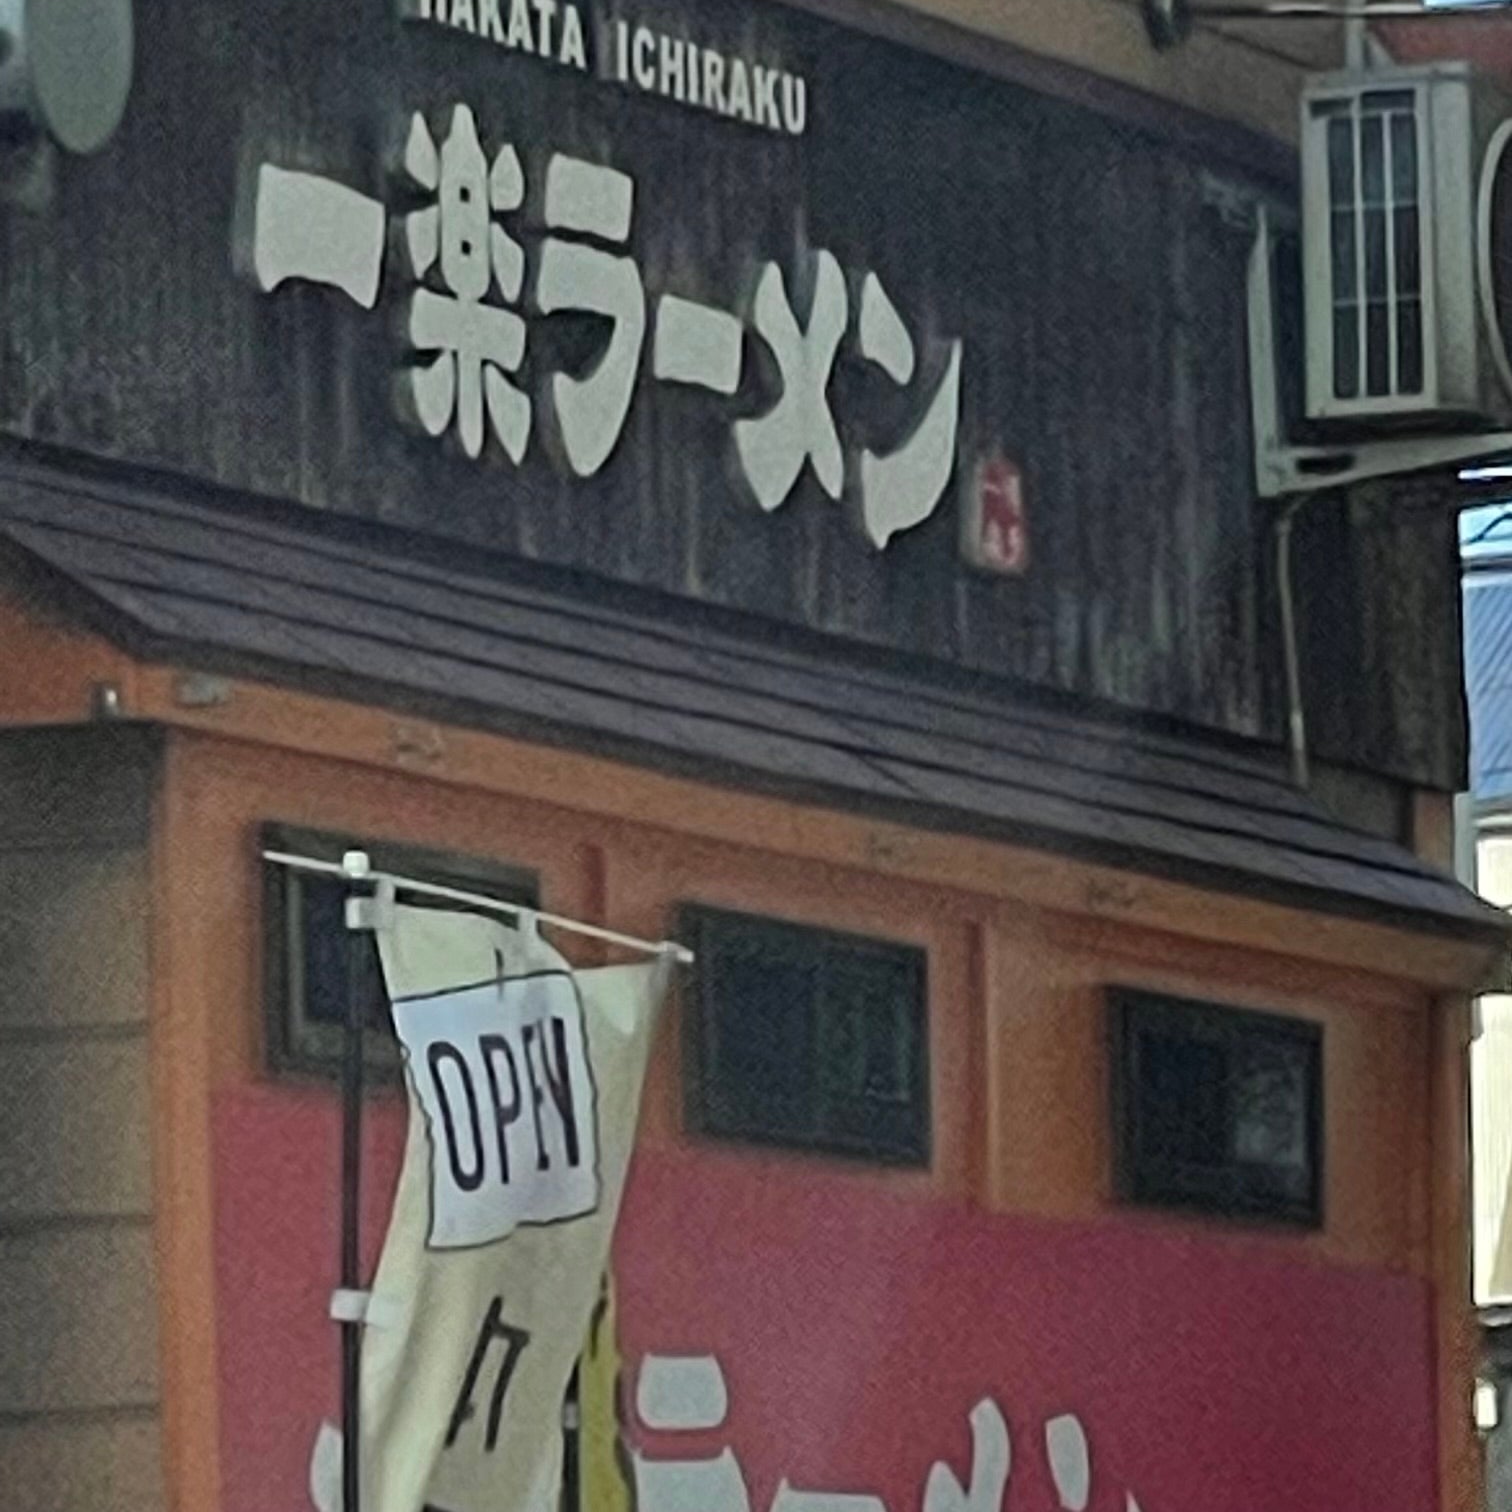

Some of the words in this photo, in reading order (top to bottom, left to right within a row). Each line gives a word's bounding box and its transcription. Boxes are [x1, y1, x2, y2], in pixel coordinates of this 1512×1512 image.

[618, 21, 805, 134] ICHIRAKU
[254, 103, 962, 550] 一楽ラーメン
